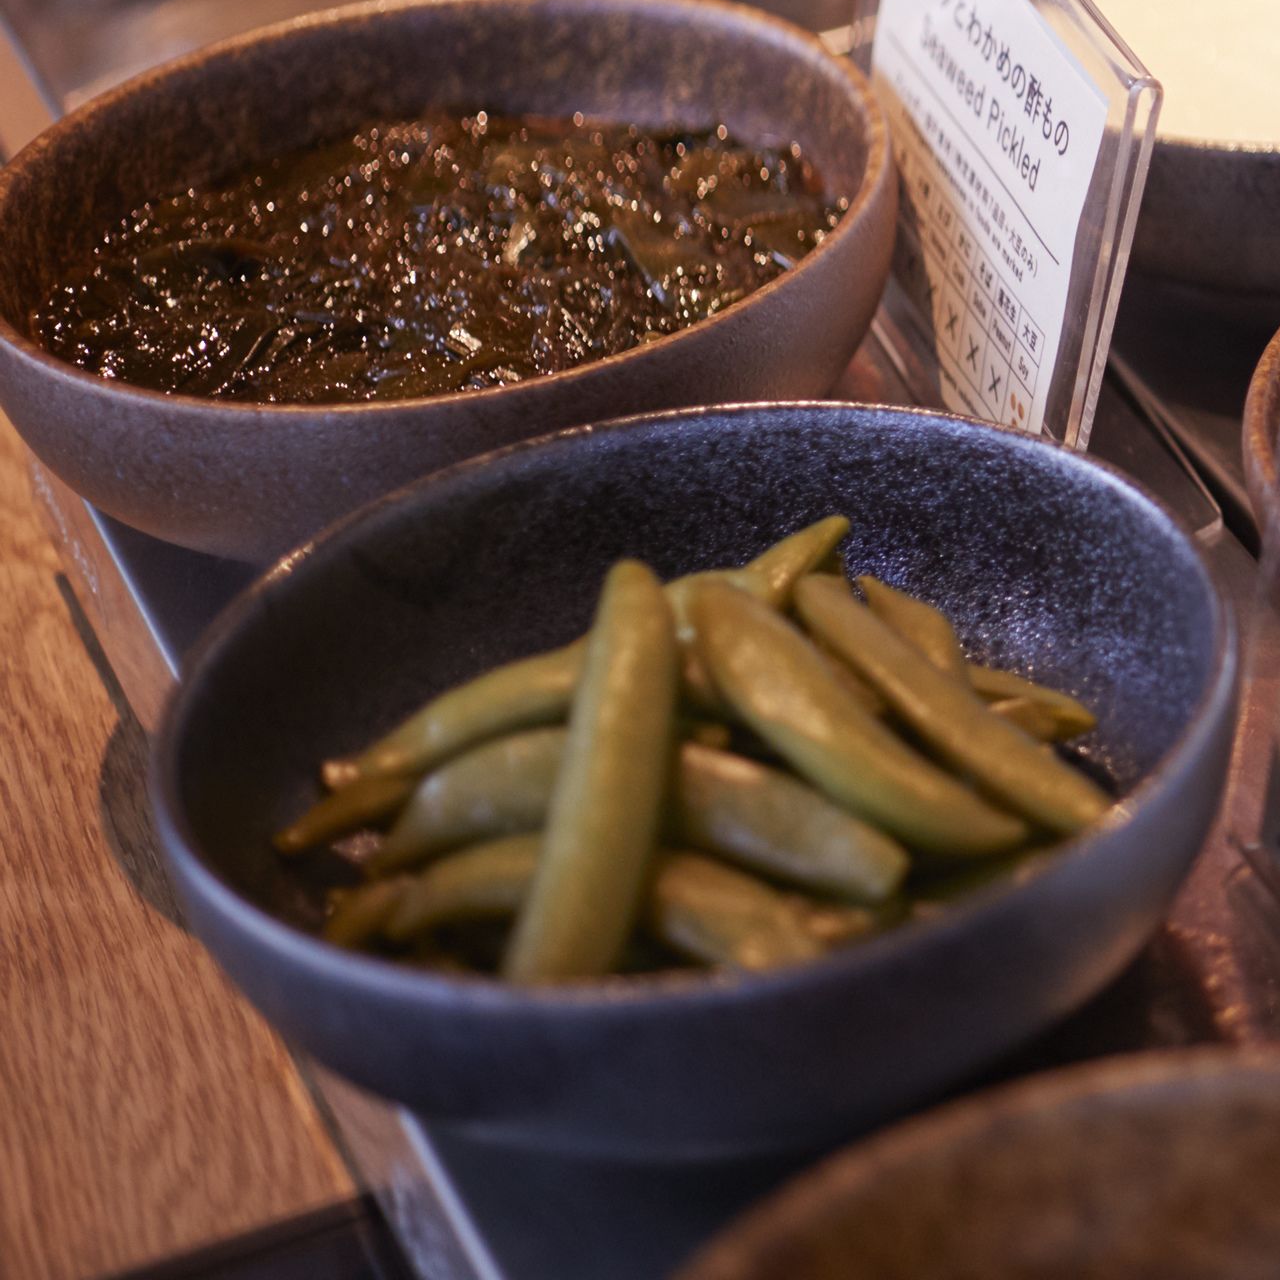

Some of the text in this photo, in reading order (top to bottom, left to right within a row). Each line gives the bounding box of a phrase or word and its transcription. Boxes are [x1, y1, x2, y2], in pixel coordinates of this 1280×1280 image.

[920, 16, 987, 118] Seaweed
[987, 97, 1041, 192] Pickled
[1023, 322, 1038, 352] 大豆
